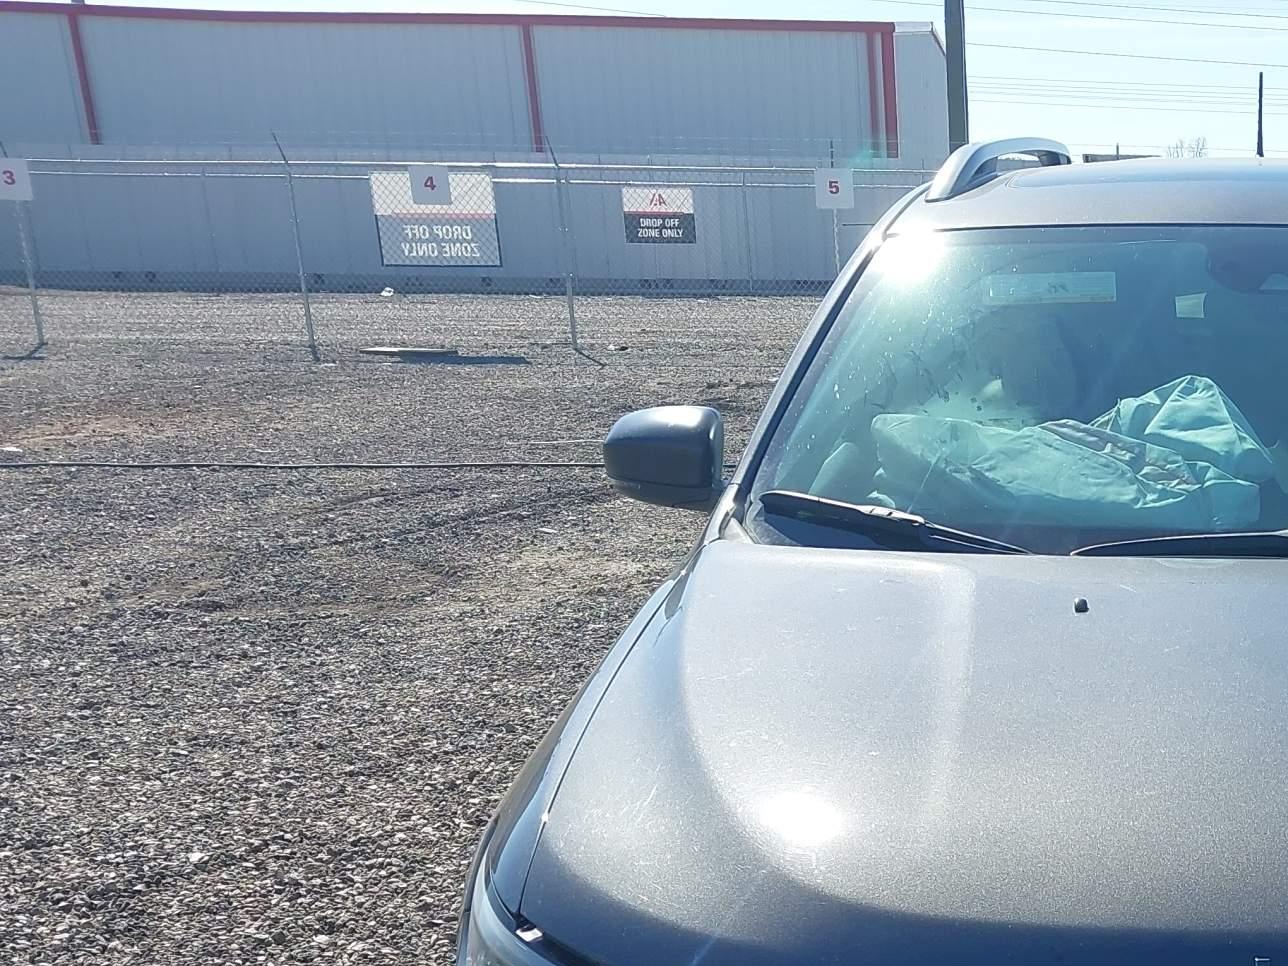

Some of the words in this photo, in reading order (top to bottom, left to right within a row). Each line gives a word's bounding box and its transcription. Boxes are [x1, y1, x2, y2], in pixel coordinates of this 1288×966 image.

[2, 170, 16, 185] 3
[423, 176, 437, 191] 4
[828, 180, 840, 195] 5
[640, 218, 663, 228] DROP
[664, 218, 680, 228] OFF
[638, 228, 660, 238] ZONE
[661, 228, 684, 238] ONLY
